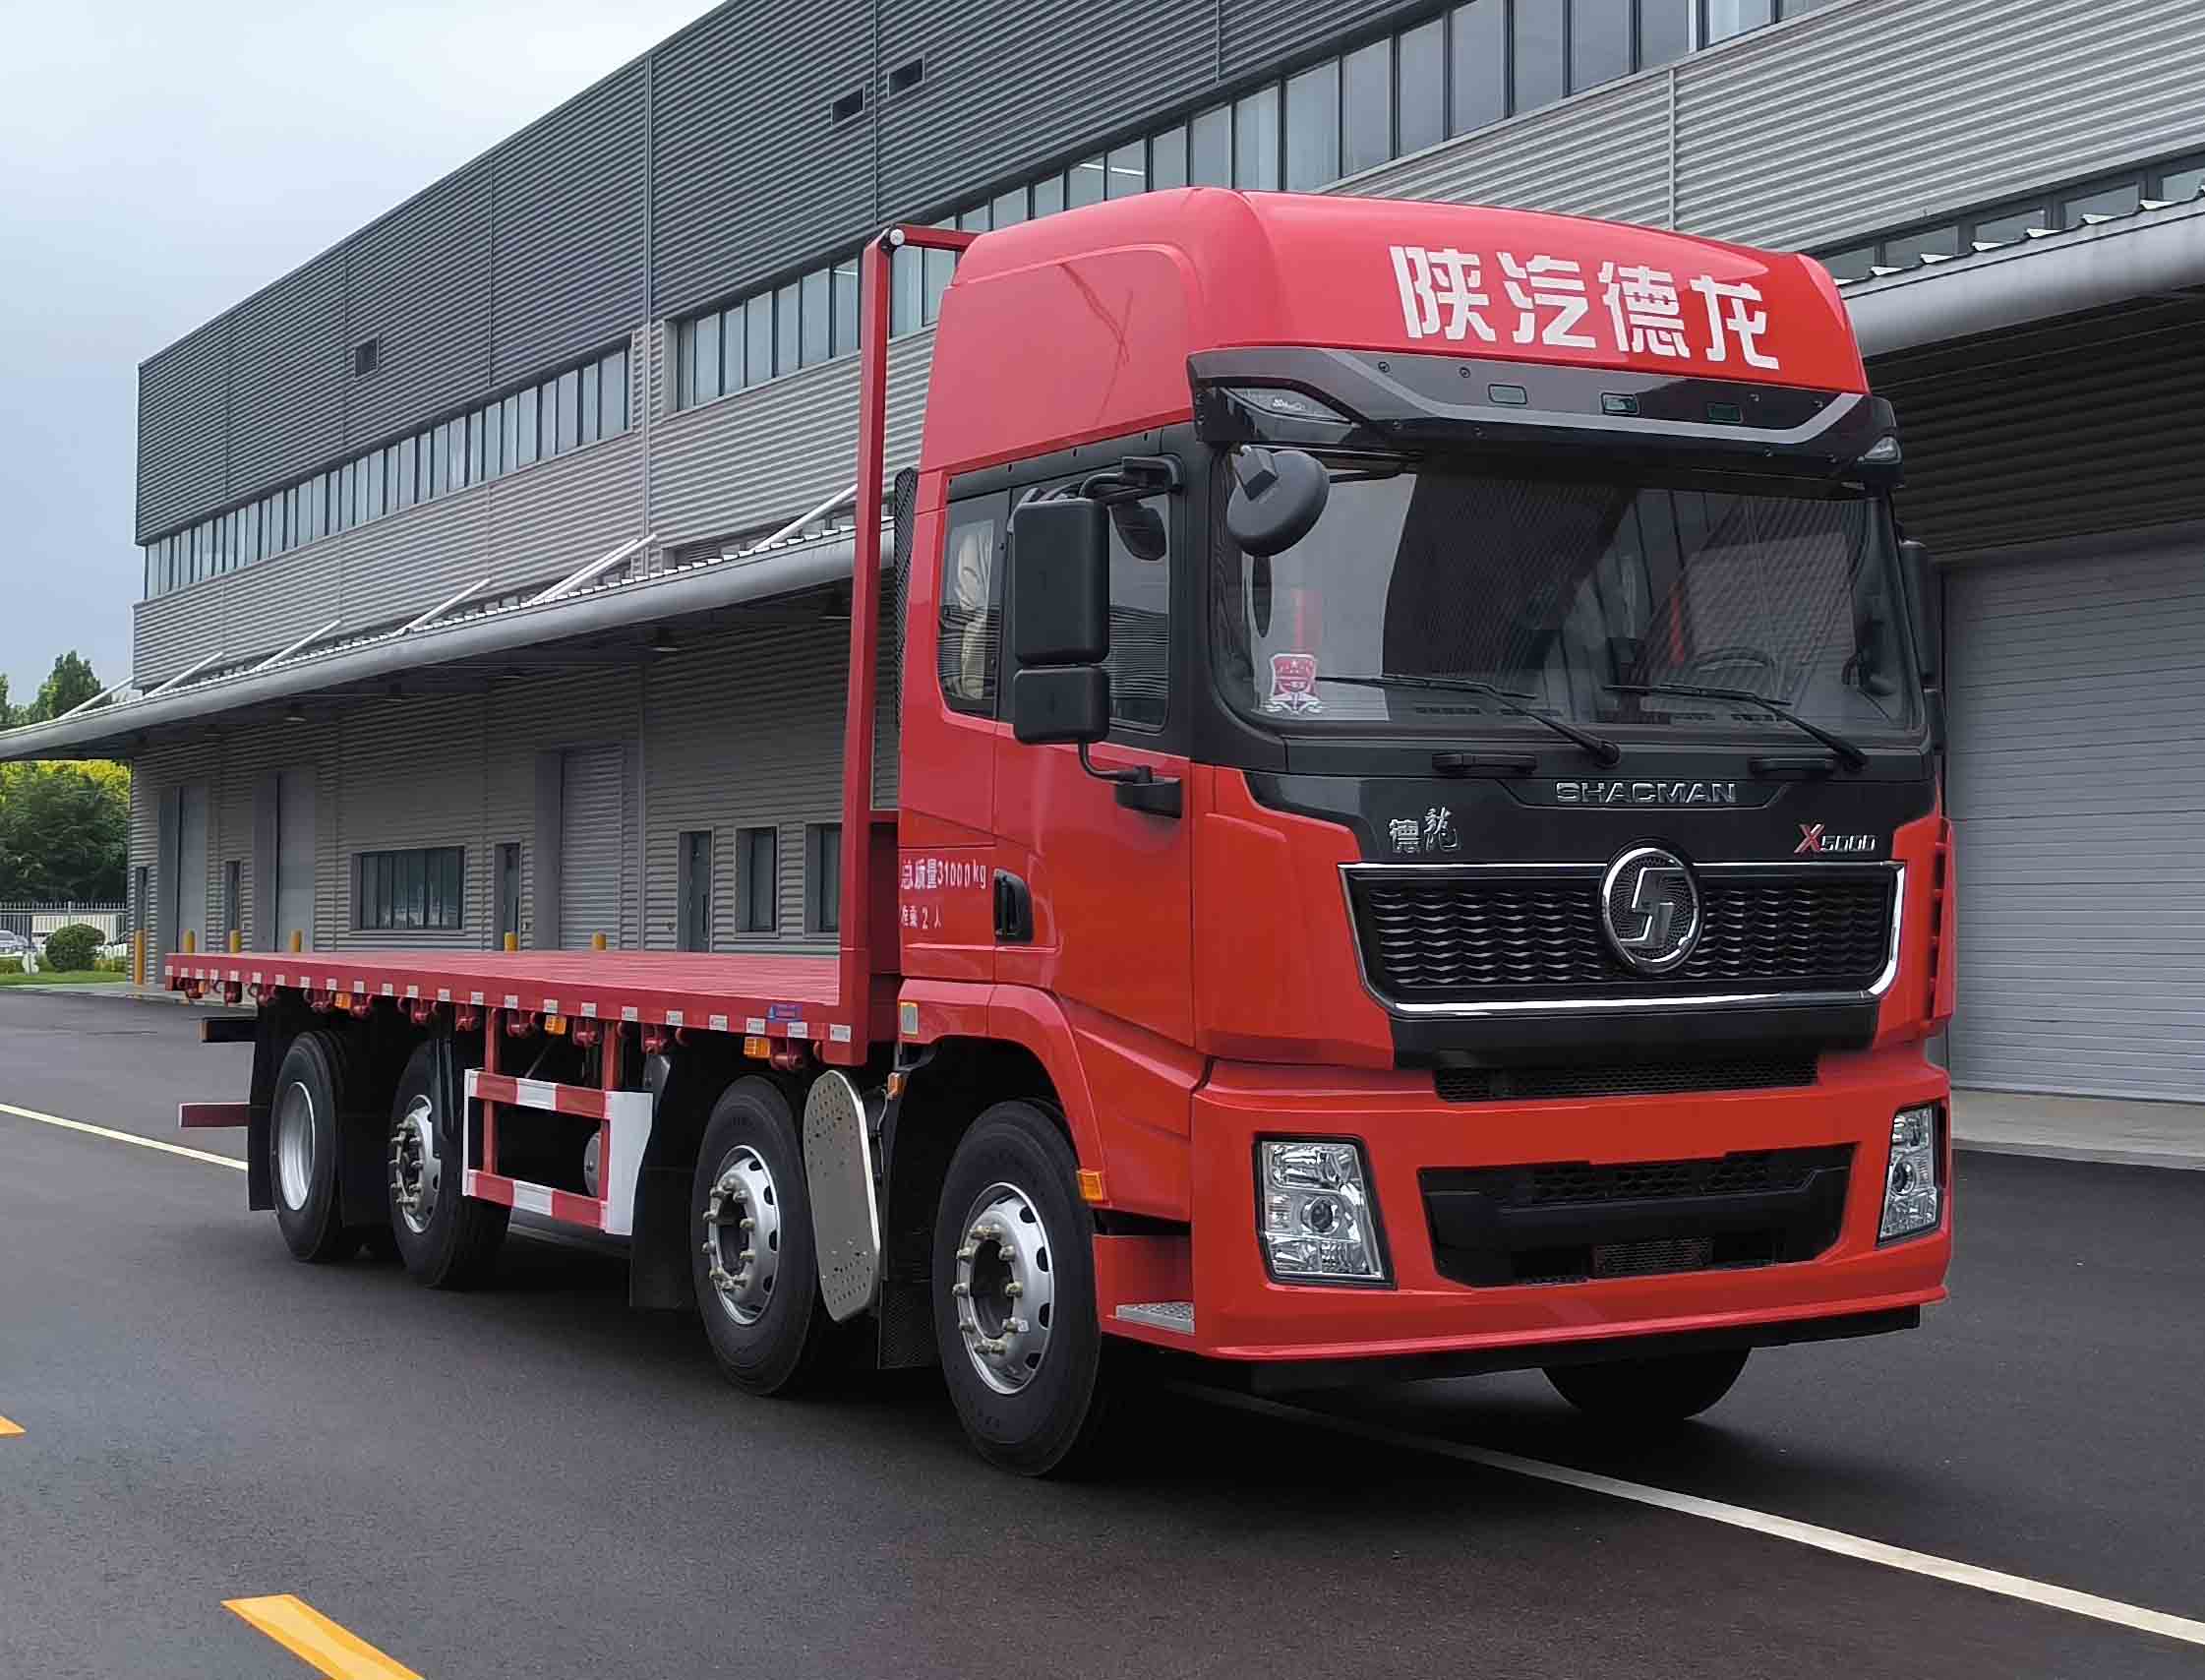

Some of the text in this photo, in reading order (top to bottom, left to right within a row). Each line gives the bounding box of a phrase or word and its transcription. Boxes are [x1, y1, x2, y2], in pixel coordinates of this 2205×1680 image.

[1389, 245, 1779, 370] 陕汽德龙
[1556, 782, 1737, 804] SHACMAN
[1793, 823, 1876, 853] X5000
